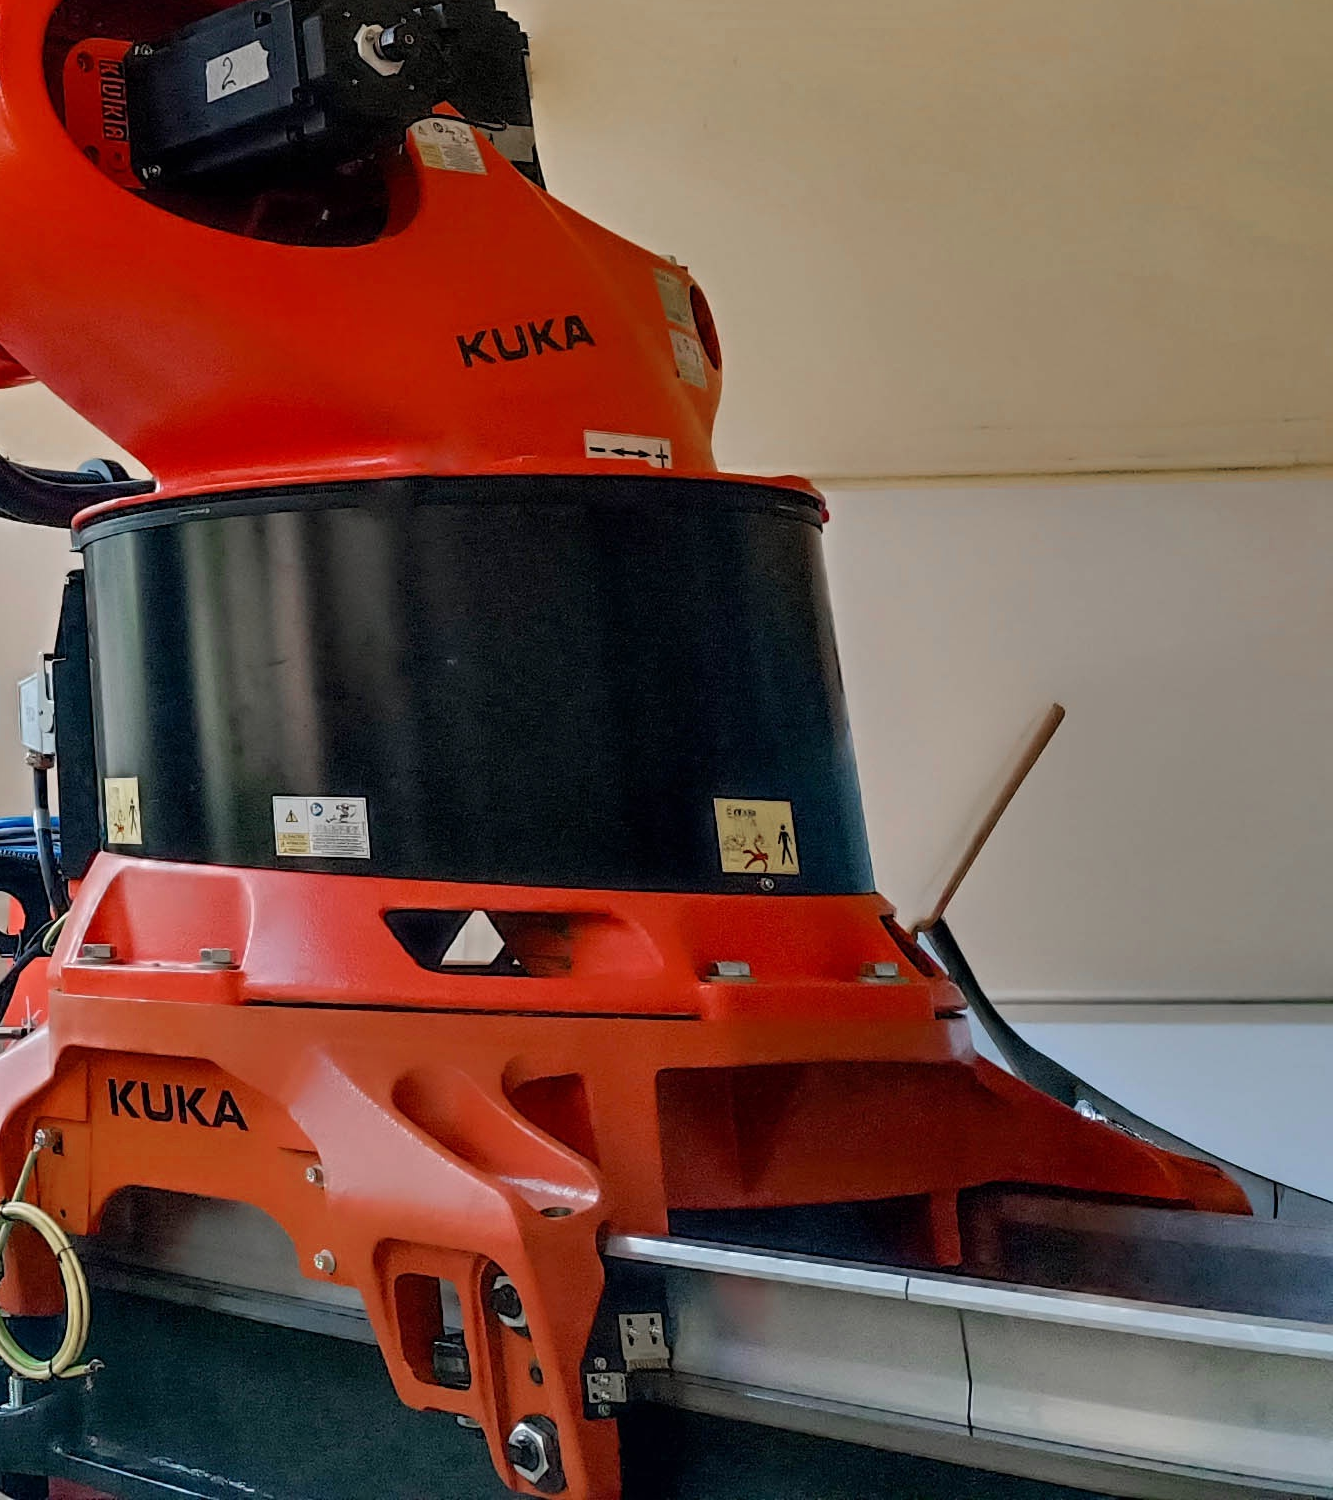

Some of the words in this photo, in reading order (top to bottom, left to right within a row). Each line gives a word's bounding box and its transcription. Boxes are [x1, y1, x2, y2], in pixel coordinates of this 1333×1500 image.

[222, 56, 237, 90] 2
[456, 314, 596, 368] KUKA
[107, 1078, 250, 1132] KUKA
